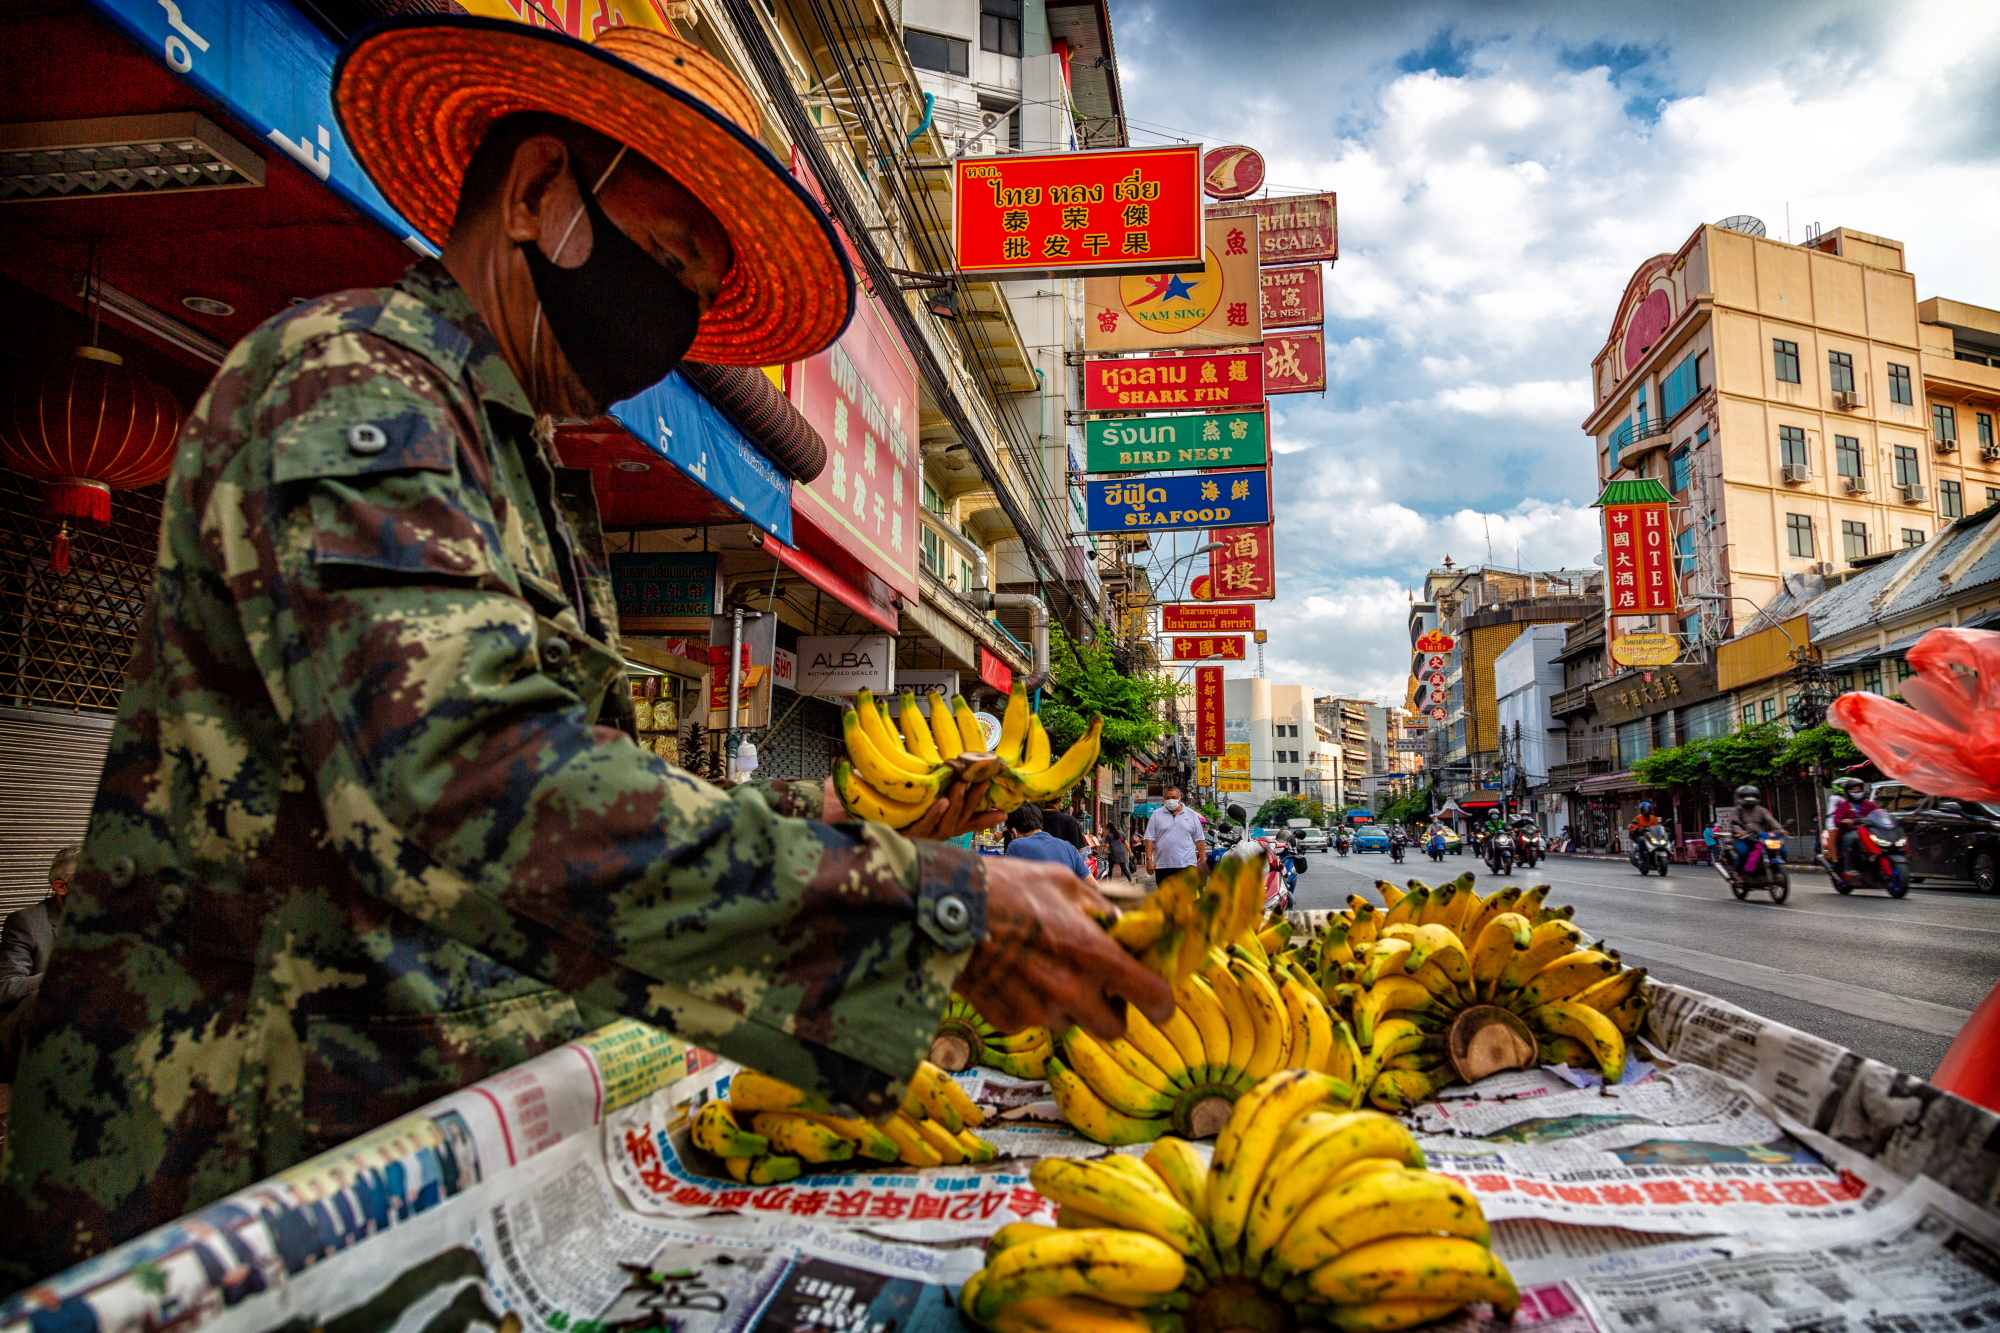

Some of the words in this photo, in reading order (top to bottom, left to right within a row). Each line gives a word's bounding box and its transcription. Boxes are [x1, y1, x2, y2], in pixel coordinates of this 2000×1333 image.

[966, 166, 1001, 178] หจก.
[988, 178, 1042, 207] ไทย
[1049, 184, 1103, 205] หลง
[1113, 168, 1160, 201] เจี่ย
[1002, 205, 1149, 232] 泰荣傑
[1003, 231, 1150, 259] 批发干果
[1264, 233, 1325, 253] SCALA
[1139, 310, 1170, 321] NAM
[1174, 308, 1207, 320] SING
[1280, 308, 1308, 317] NEST
[1101, 366, 1187, 393] หูฉลาม
[1200, 360, 1249, 383] 魚翅
[1119, 390, 1189, 404] SHARK
[1194, 387, 1230, 401] FIN
[861, 376, 886, 443] หลง
[1102, 422, 1176, 446] รังนก
[1202, 418, 1249, 441] 燕窩
[1119, 450, 1171, 464] BIRD
[1178, 447, 1233, 462] NEST
[1201, 479, 1250, 501] 海鮮
[1125, 508, 1231, 525] SEAFOOD
[1221, 532, 1264, 591] 酒樓
[1613, 512, 1635, 607] 中國大酒店
[1645, 511, 1664, 606] HOTEL
[653, 603, 708, 615] EXCHANGE
[1177, 639, 1238, 658] 中國城
[1616, 645, 1647, 655] CHINA
[811, 653, 874, 668] ALBA
[1203, 671, 1217, 753] 銀都魚翅酒樓
